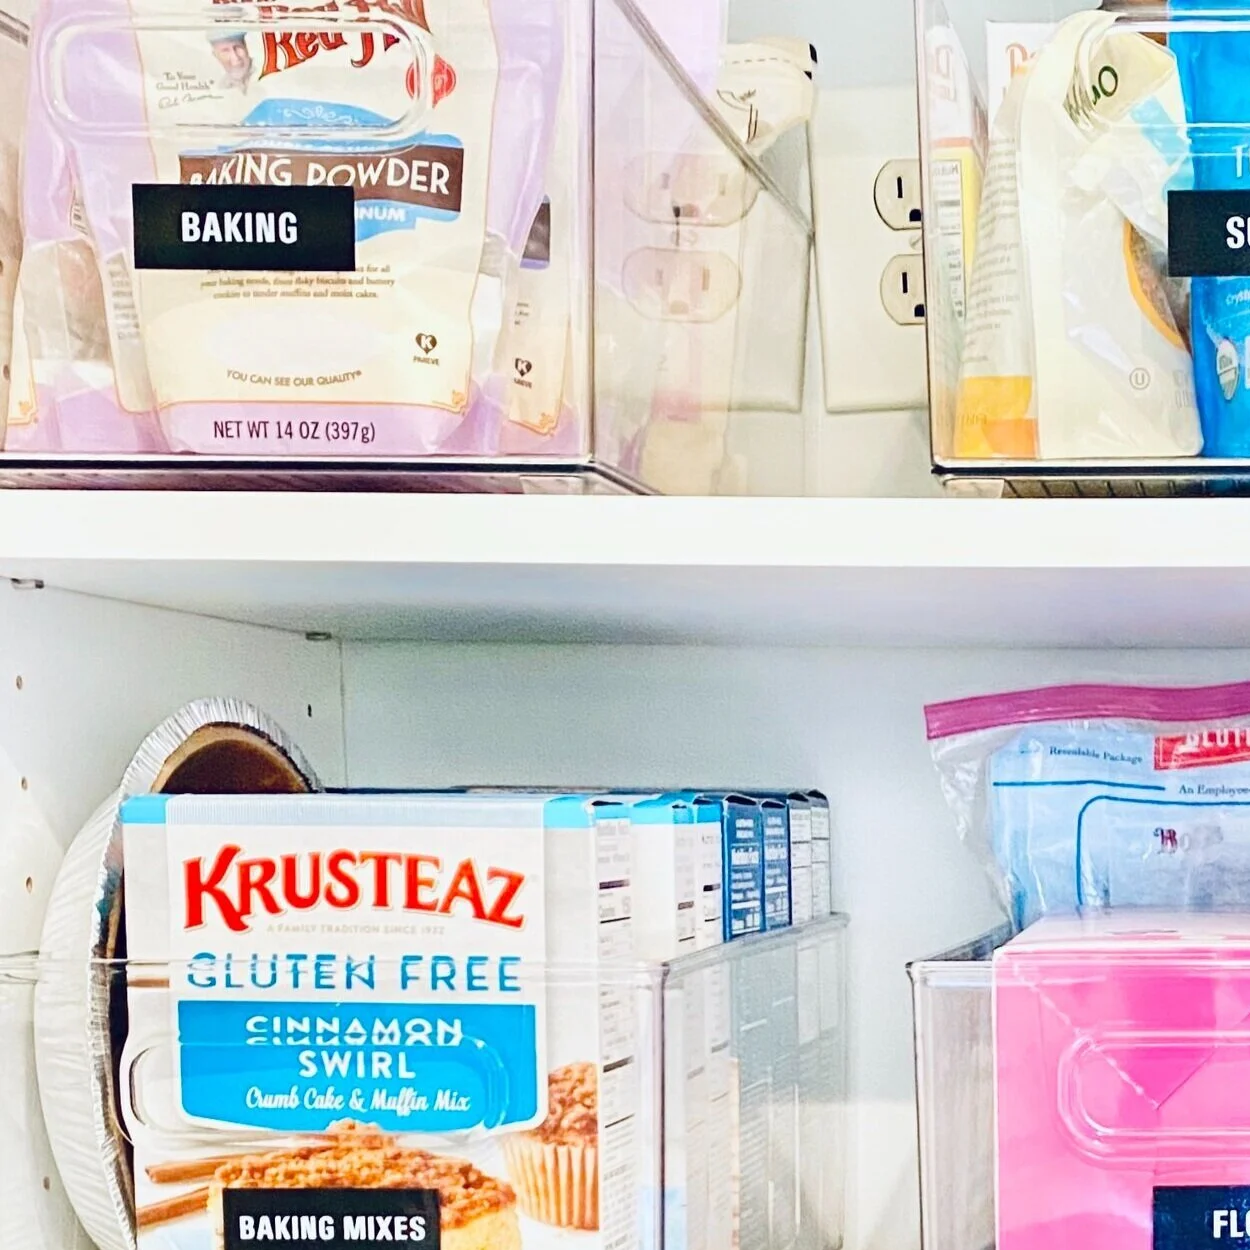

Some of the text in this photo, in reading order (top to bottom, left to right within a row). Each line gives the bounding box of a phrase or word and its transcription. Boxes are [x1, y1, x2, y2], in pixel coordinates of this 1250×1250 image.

[307, 155, 449, 195] POWDER
[181, 211, 298, 243] BAKING
[226, 368, 315, 386] YOU CAN SEE OUR
[214, 420, 376, 443] NET WT 14 OZ (397g)
[1103, 751, 1143, 764] Package
[1179, 783, 1195, 795] An
[182, 843, 527, 932] KRUSTEAZ
[277, 923, 317, 934] FAMILY
[321, 923, 380, 934] TRADITION
[384, 923, 417, 934] SINCE
[186, 952, 521, 992] GLUTEN FREE
[245, 1015, 463, 1045] CINNAMON
[299, 1050, 416, 1079] SWIRL
[246, 1086, 472, 1116] Crumb Cake & Muffin Mix
[240, 1215, 426, 1241] BAKING MIXES
